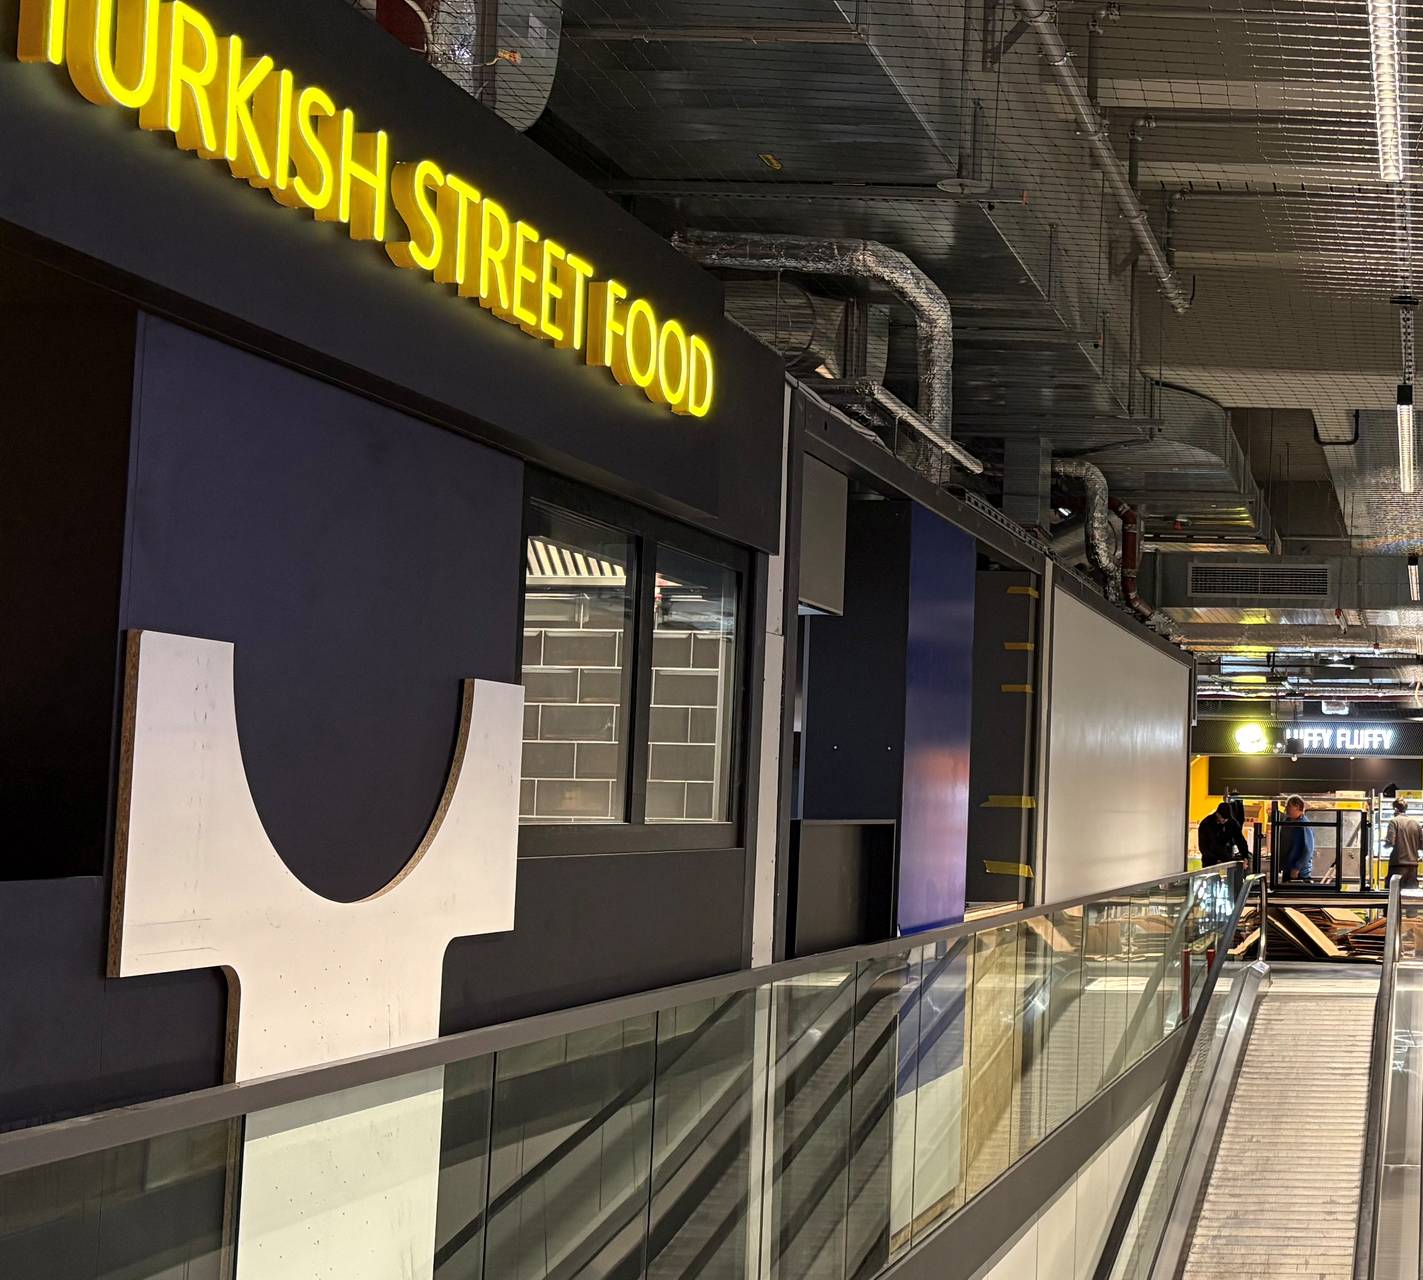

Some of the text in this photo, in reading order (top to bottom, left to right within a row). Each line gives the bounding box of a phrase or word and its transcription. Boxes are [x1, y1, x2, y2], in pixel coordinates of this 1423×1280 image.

[408, 160, 594, 350] STREET
[604, 279, 714, 418] FOOD
[1336, 728, 1393, 749] FLUFFY
